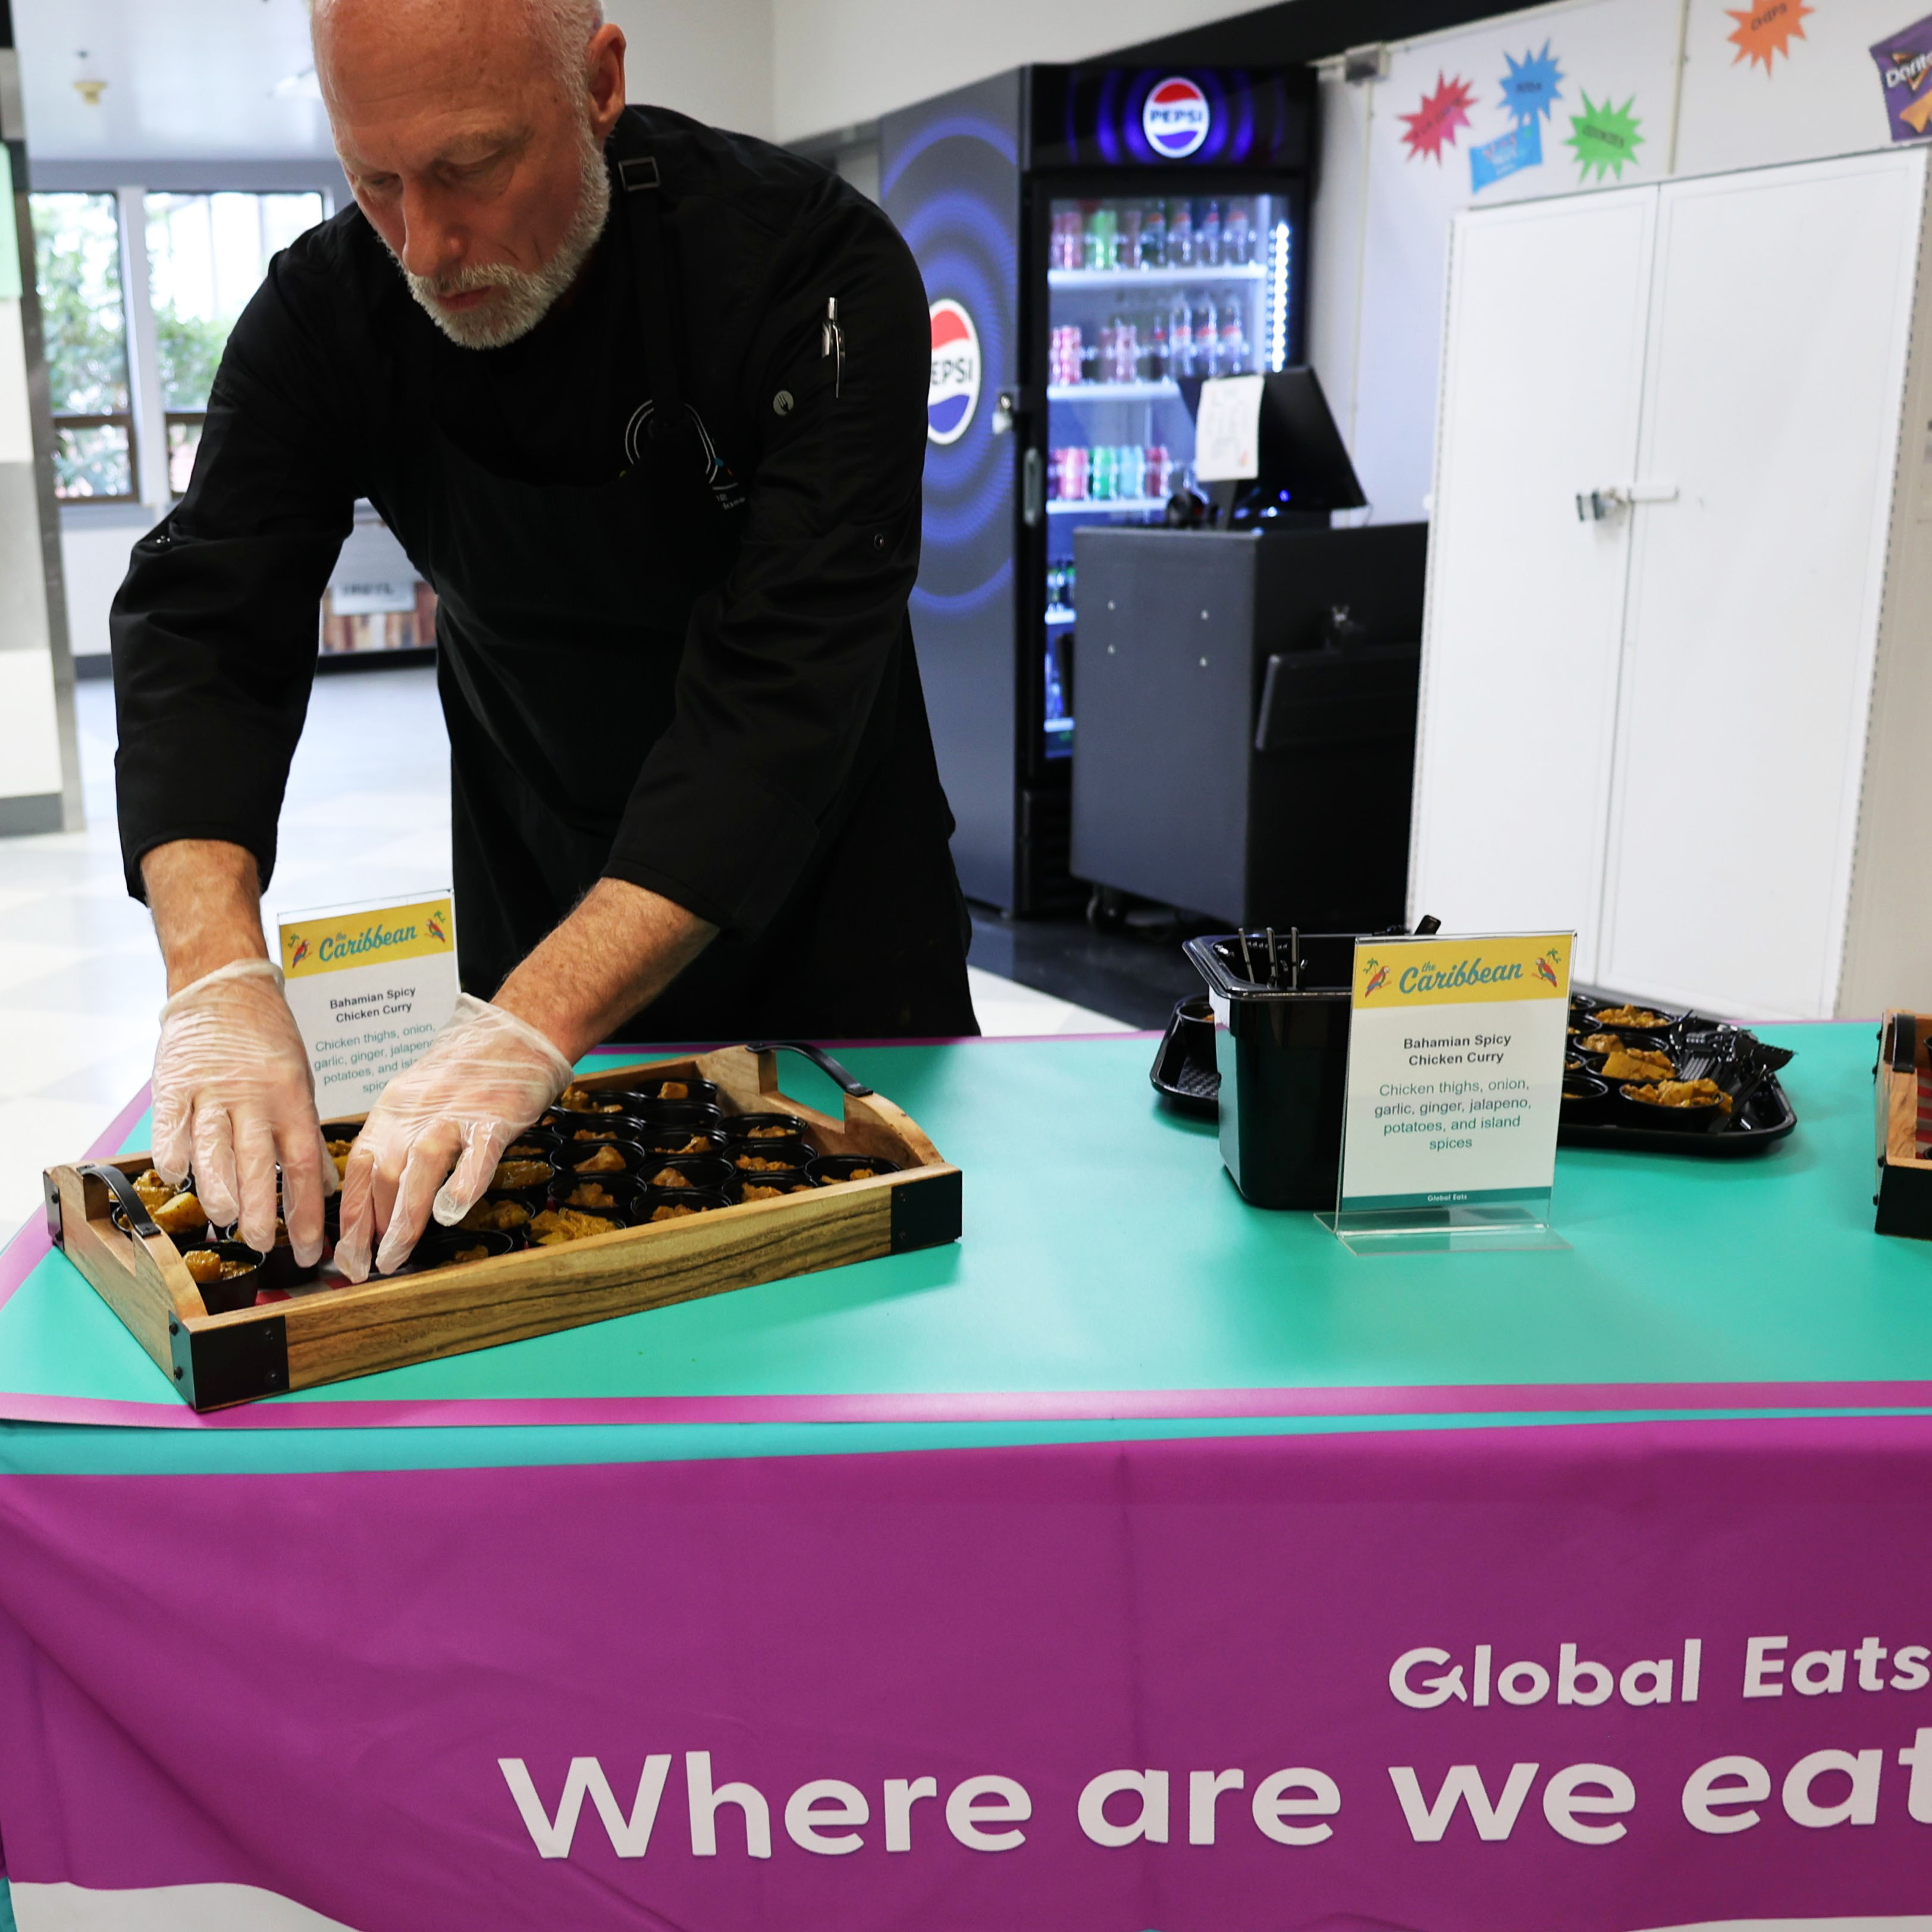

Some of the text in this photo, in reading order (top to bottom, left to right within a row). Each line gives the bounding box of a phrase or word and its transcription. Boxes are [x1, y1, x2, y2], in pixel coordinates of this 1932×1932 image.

[1150, 109, 1203, 123] PEPSI
[931, 358, 973, 385] EPSI
[319, 924, 418, 962] Caribbean
[335, 932, 347, 942] the
[1399, 958, 1523, 994] Caribbean
[1421, 961, 1437, 973] the
[330, 987, 416, 1009] Bahamian Spicy
[335, 1003, 412, 1023] Chicken Curry
[315, 1024, 435, 1052] Chicken thighs, onion,
[1404, 1034, 1511, 1049] Bahamian Spicy
[314, 1055, 347, 1071] garlic,
[350, 1049, 387, 1065] ginger,
[1409, 1052, 1504, 1066] Chicken Curry
[323, 1058, 418, 1085] potatoes, and isl
[362, 1080, 389, 1093] spic
[1379, 1078, 1529, 1097] Chicken thighs, onion,
[1375, 1097, 1531, 1116] garlic, ginger, jalapeno,
[1384, 1115, 1520, 1136] potatoes, and island
[1429, 1138, 1472, 1152] spices
[1427, 1194, 1451, 1202] Global
[1389, 1636, 1931, 1708] Global Eats
[497, 1727, 1932, 1859] Where are we eat
